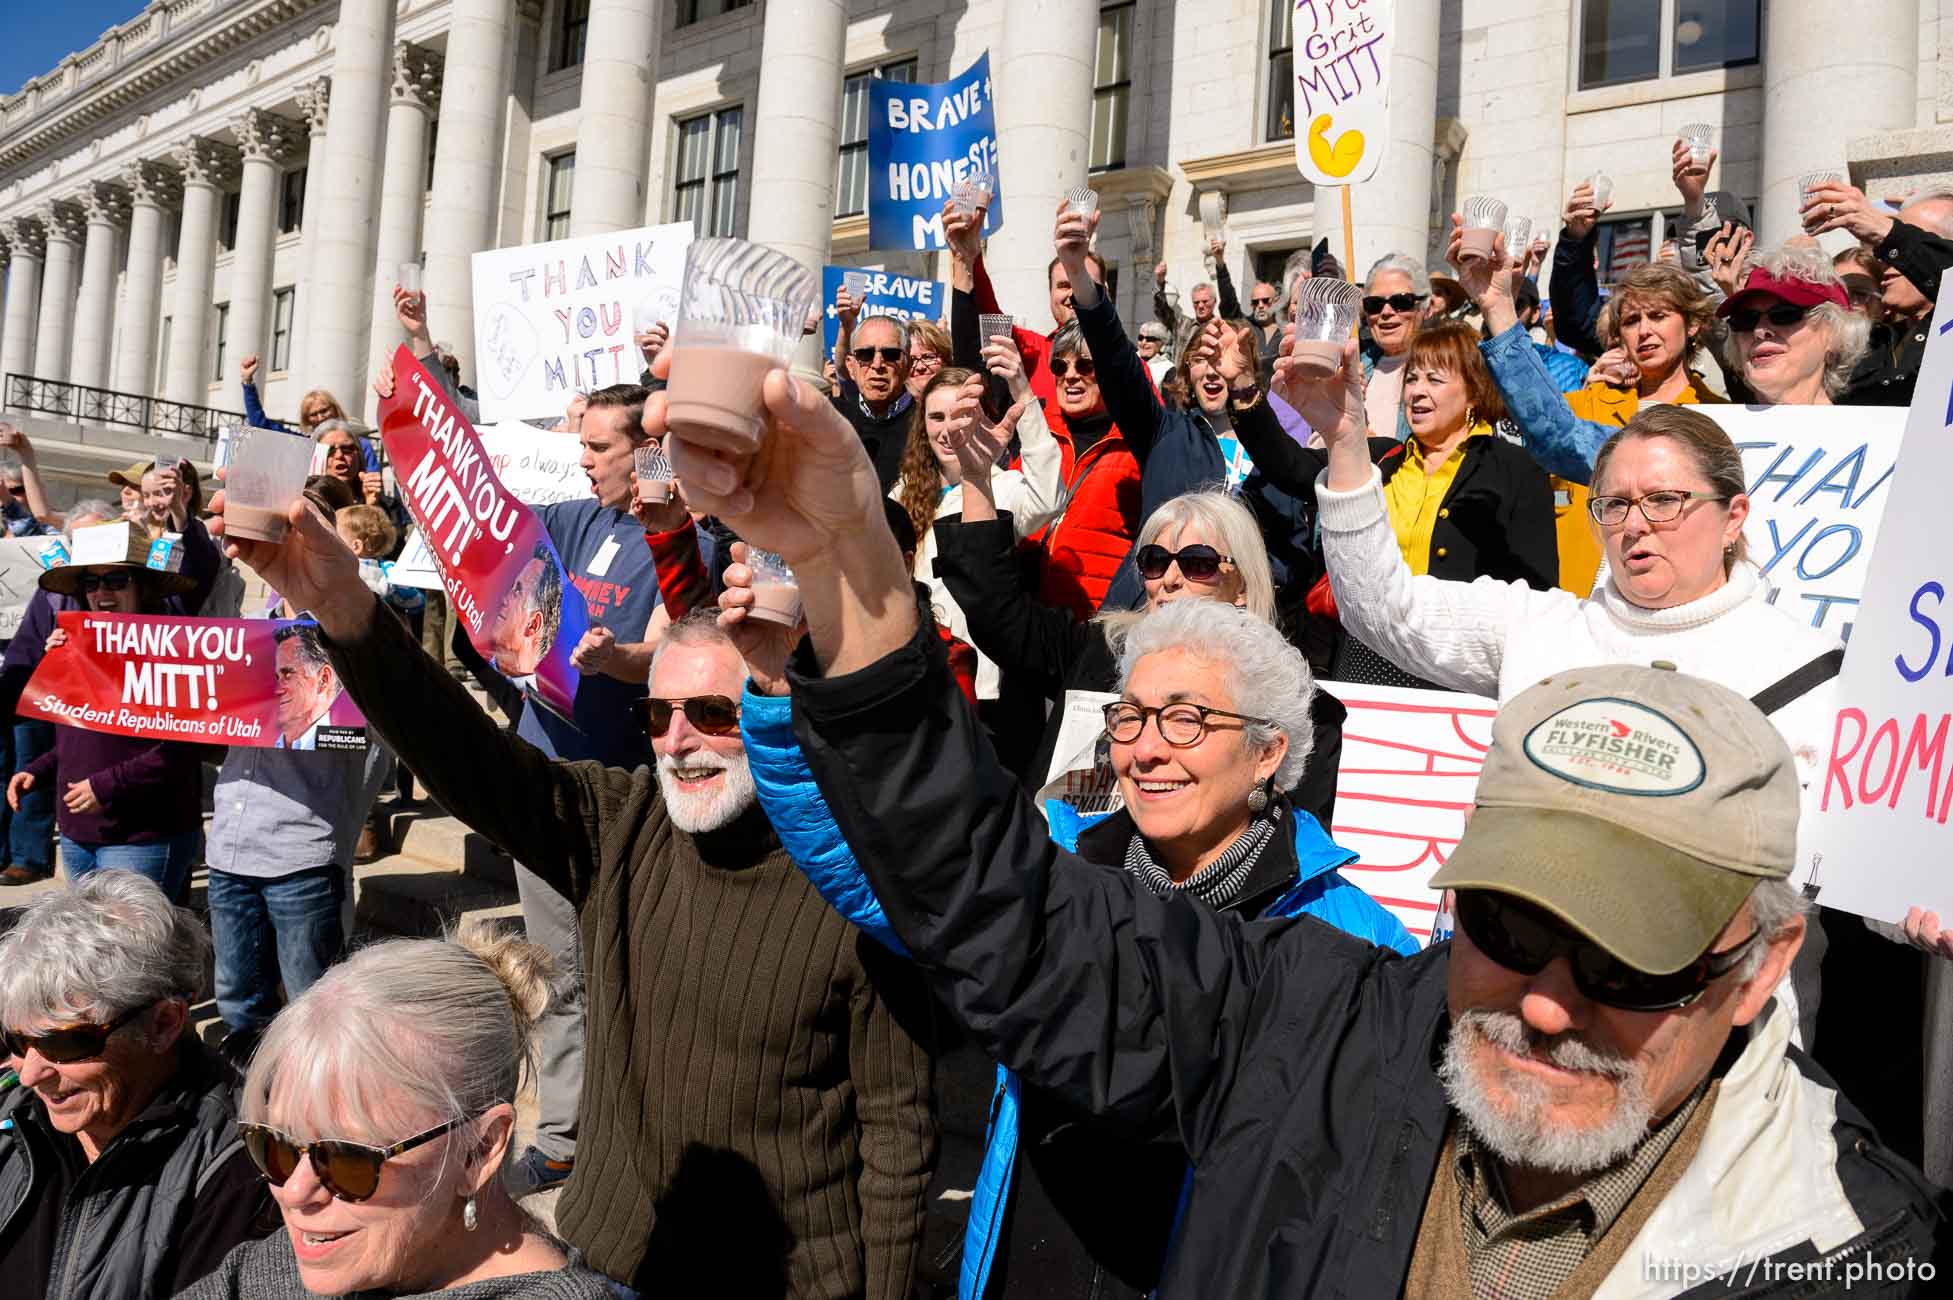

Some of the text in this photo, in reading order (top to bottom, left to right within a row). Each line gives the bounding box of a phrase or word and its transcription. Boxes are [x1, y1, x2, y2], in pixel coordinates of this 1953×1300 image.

[1305, 11, 1375, 60] Grit
[1297, 32, 1385, 118] MITT
[888, 81, 980, 133] BRAVE
[509, 240, 656, 302] THANK
[862, 273, 932, 305] BRAVE
[553, 300, 622, 344] YOU
[544, 344, 625, 391] MITT
[471, 463, 519, 555] YOU,
[1758, 517, 1863, 581] YO
[447, 578, 462, 597] of
[458, 588, 485, 634] Utah
[187, 625, 252, 666] YOU,
[33, 694, 261, 738] -Student Republicans of Utah
[318, 734, 367, 745] REPUBLICANS
[1554, 718, 1681, 755] Western Rivers
[1546, 730, 1676, 770] FLYFISHER
[1820, 707, 1953, 824] ROM
